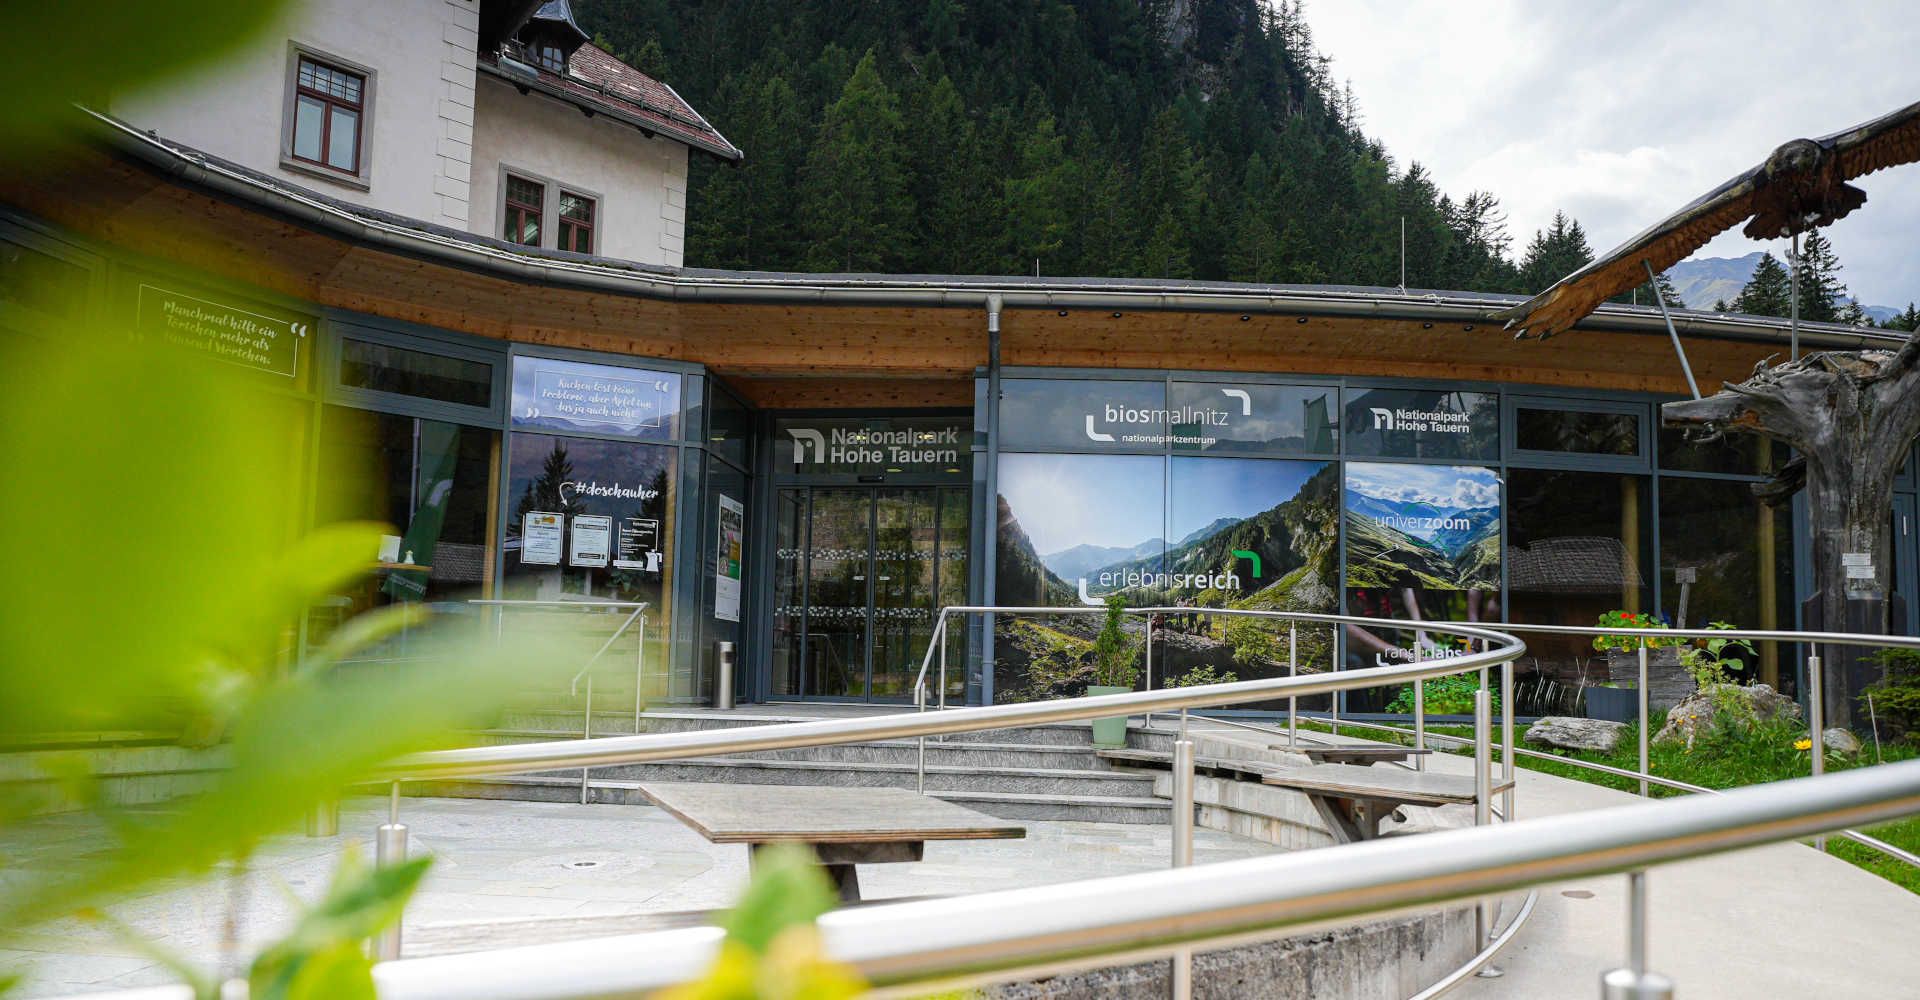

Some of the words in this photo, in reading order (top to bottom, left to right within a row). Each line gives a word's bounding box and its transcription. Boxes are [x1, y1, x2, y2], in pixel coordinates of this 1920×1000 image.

[1105, 403, 1228, 426] biosmallnitz
[1396, 408, 1470, 423] Nationalpark
[1396, 420, 1427, 431] Hohe
[1430, 421, 1470, 433] Tauern
[831, 427, 957, 446] Nationalpark
[1122, 433, 1216, 445] nationalparkzentrum
[831, 447, 884, 464] Hohe
[888, 446, 957, 464] Tauern
[576, 481, 659, 502] #doschauher
[1375, 512, 1470, 531] univerzoom
[1100, 567, 1240, 590] erlebnisreich
